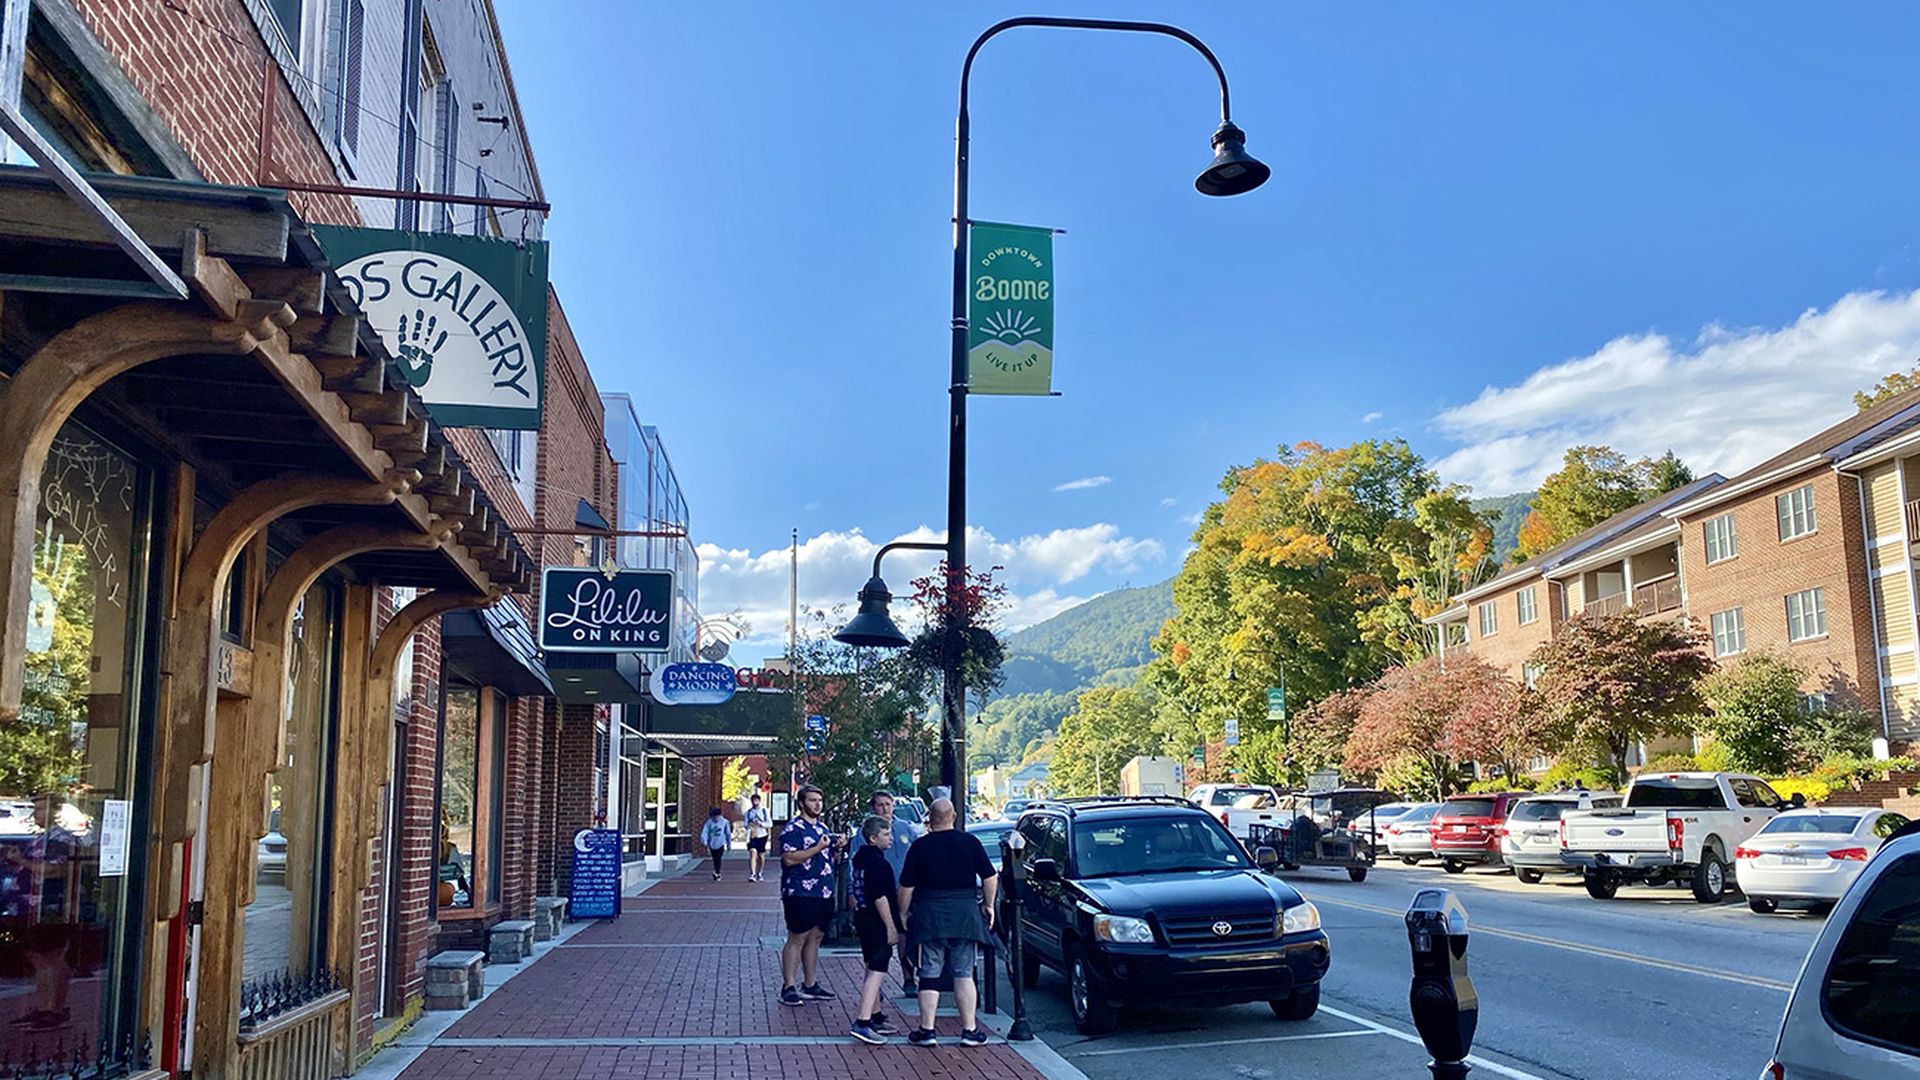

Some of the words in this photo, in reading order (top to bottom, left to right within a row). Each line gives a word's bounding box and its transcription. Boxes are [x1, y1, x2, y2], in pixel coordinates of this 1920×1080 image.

[981, 247, 1043, 269] DOWNTOWN
[975, 275, 1050, 301] Boone
[401, 258, 530, 399] GALLERY
[985, 351, 1008, 373] LIVE
[1012, 362, 1023, 373] IT
[1025, 352, 1039, 368] UP
[45, 482, 122, 608] GALLERY
[548, 577, 667, 628] Lililu
[572, 628, 601, 640] ON
[610, 629, 661, 642] KING
[668, 670, 730, 681] DANCING
[677, 681, 720, 690] MOON
